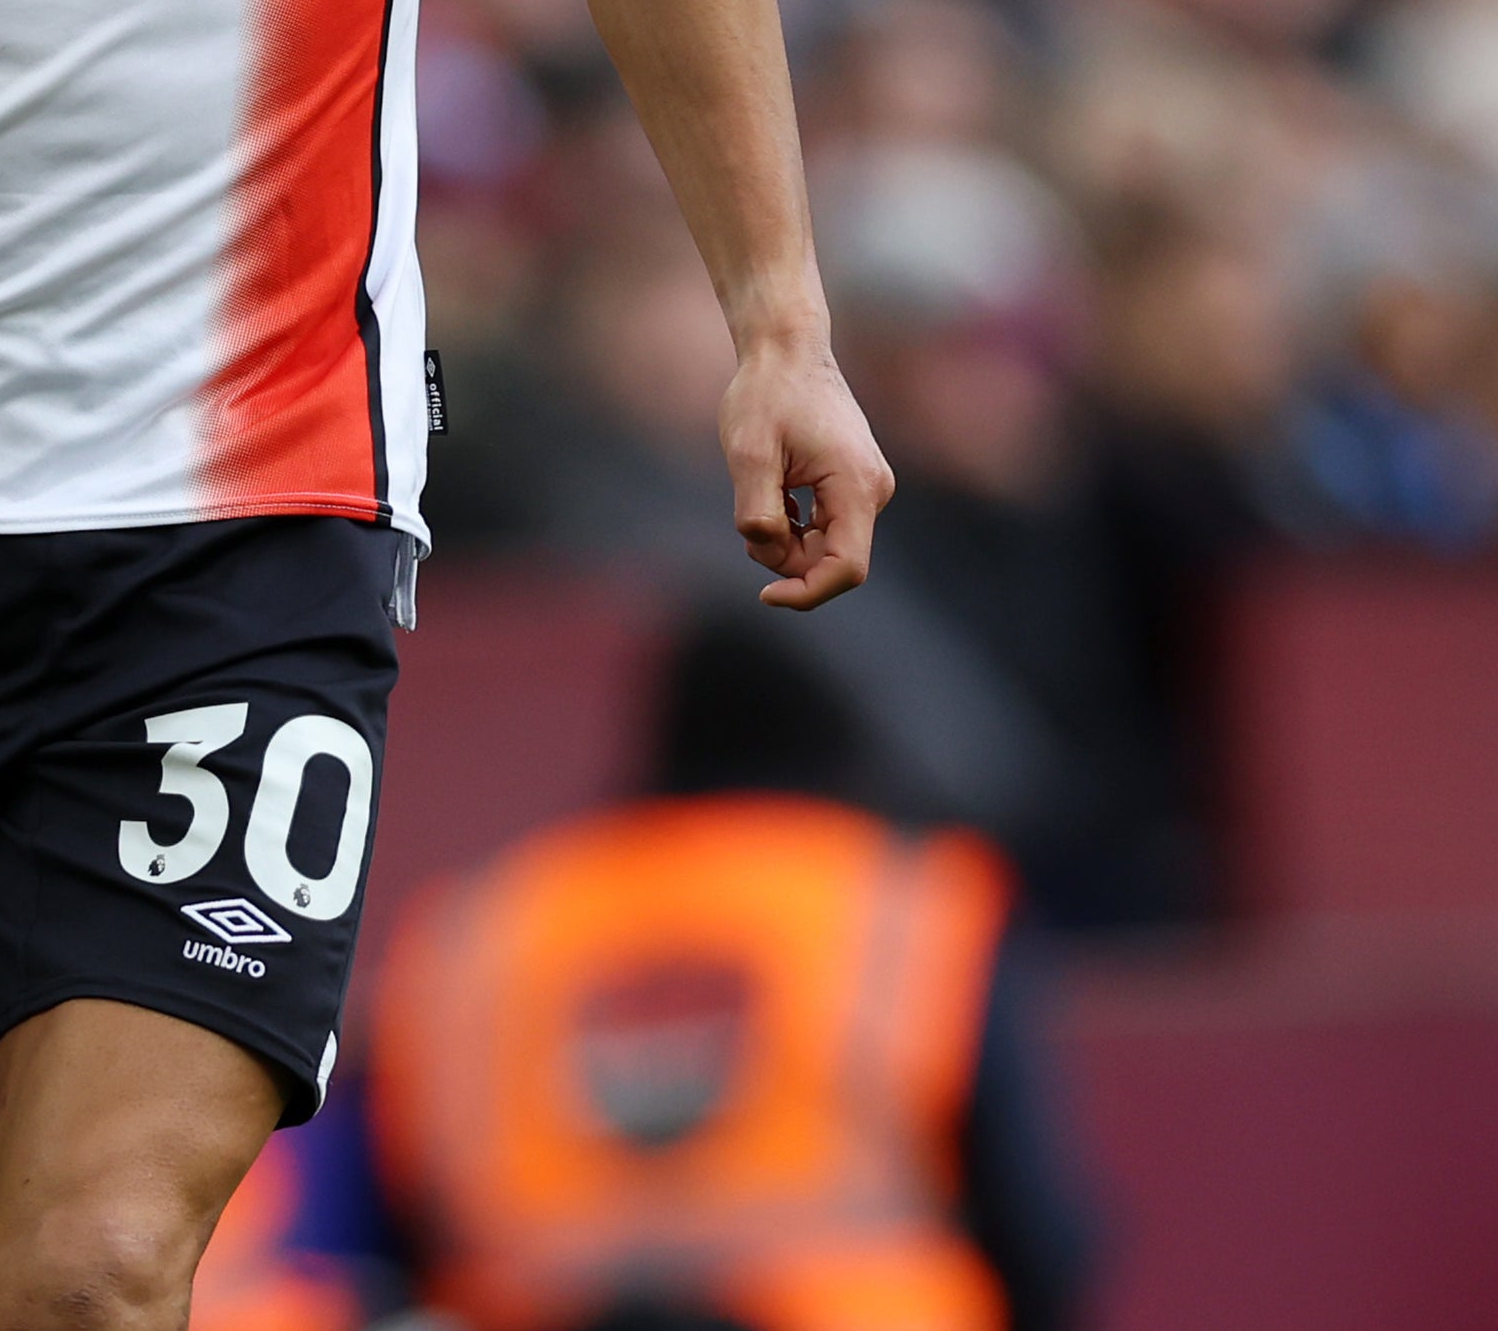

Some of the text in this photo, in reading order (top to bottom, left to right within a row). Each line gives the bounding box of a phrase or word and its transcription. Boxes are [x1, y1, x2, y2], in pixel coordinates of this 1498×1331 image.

[429, 383, 444, 431] official
[118, 702, 374, 921] 30
[183, 940, 266, 978] umbro
